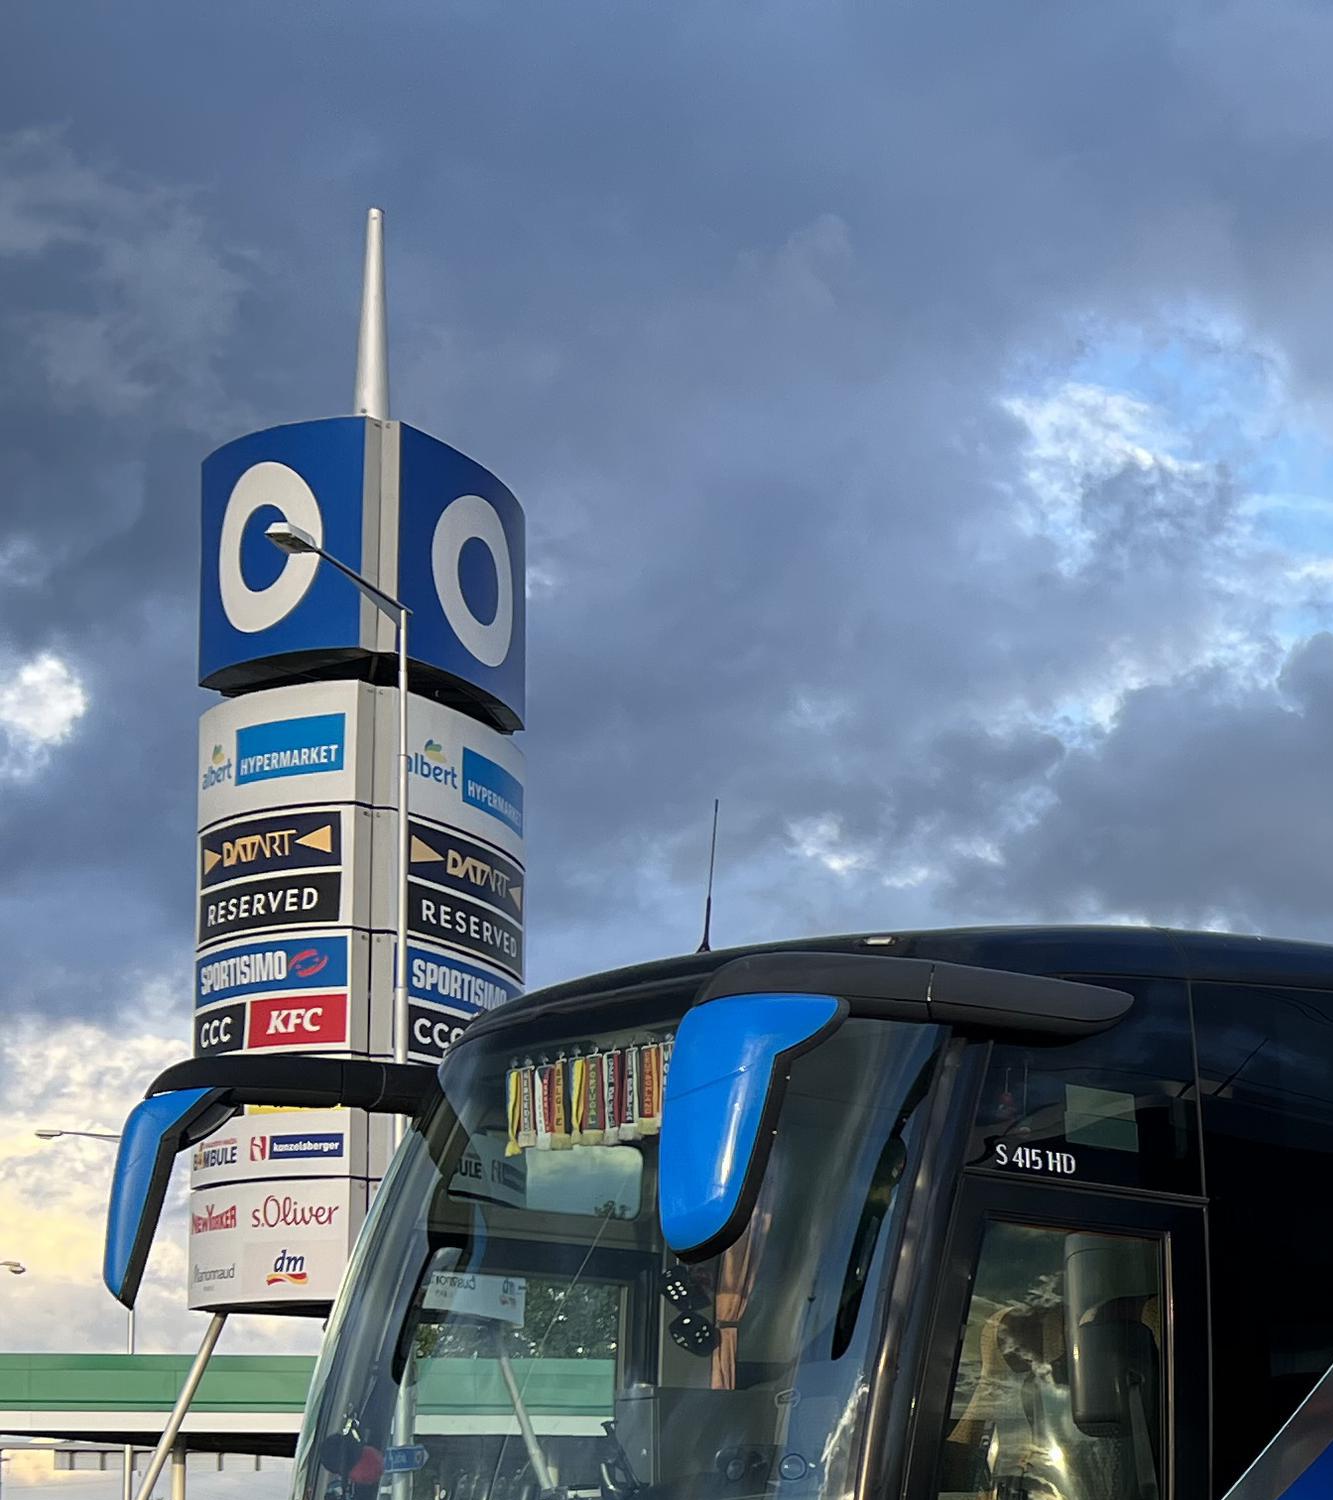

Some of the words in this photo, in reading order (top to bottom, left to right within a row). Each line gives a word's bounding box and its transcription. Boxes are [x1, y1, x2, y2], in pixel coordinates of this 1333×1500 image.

[240, 744, 338, 776] HYPERMARKET
[222, 829, 297, 868] DATART
[207, 887, 319, 927] RESERVED
[421, 899, 517, 958] RESERVED
[200, 950, 287, 995] SPORTISIMO
[200, 1016, 232, 1048] CCC
[266, 1007, 323, 1035] KFC
[995, 1143, 1008, 1166] S
[1012, 1146, 1042, 1170] 415
[1046, 1150, 1076, 1174] HD
[251, 1195, 339, 1228] s.Oliver
[273, 1249, 305, 1272] dm
